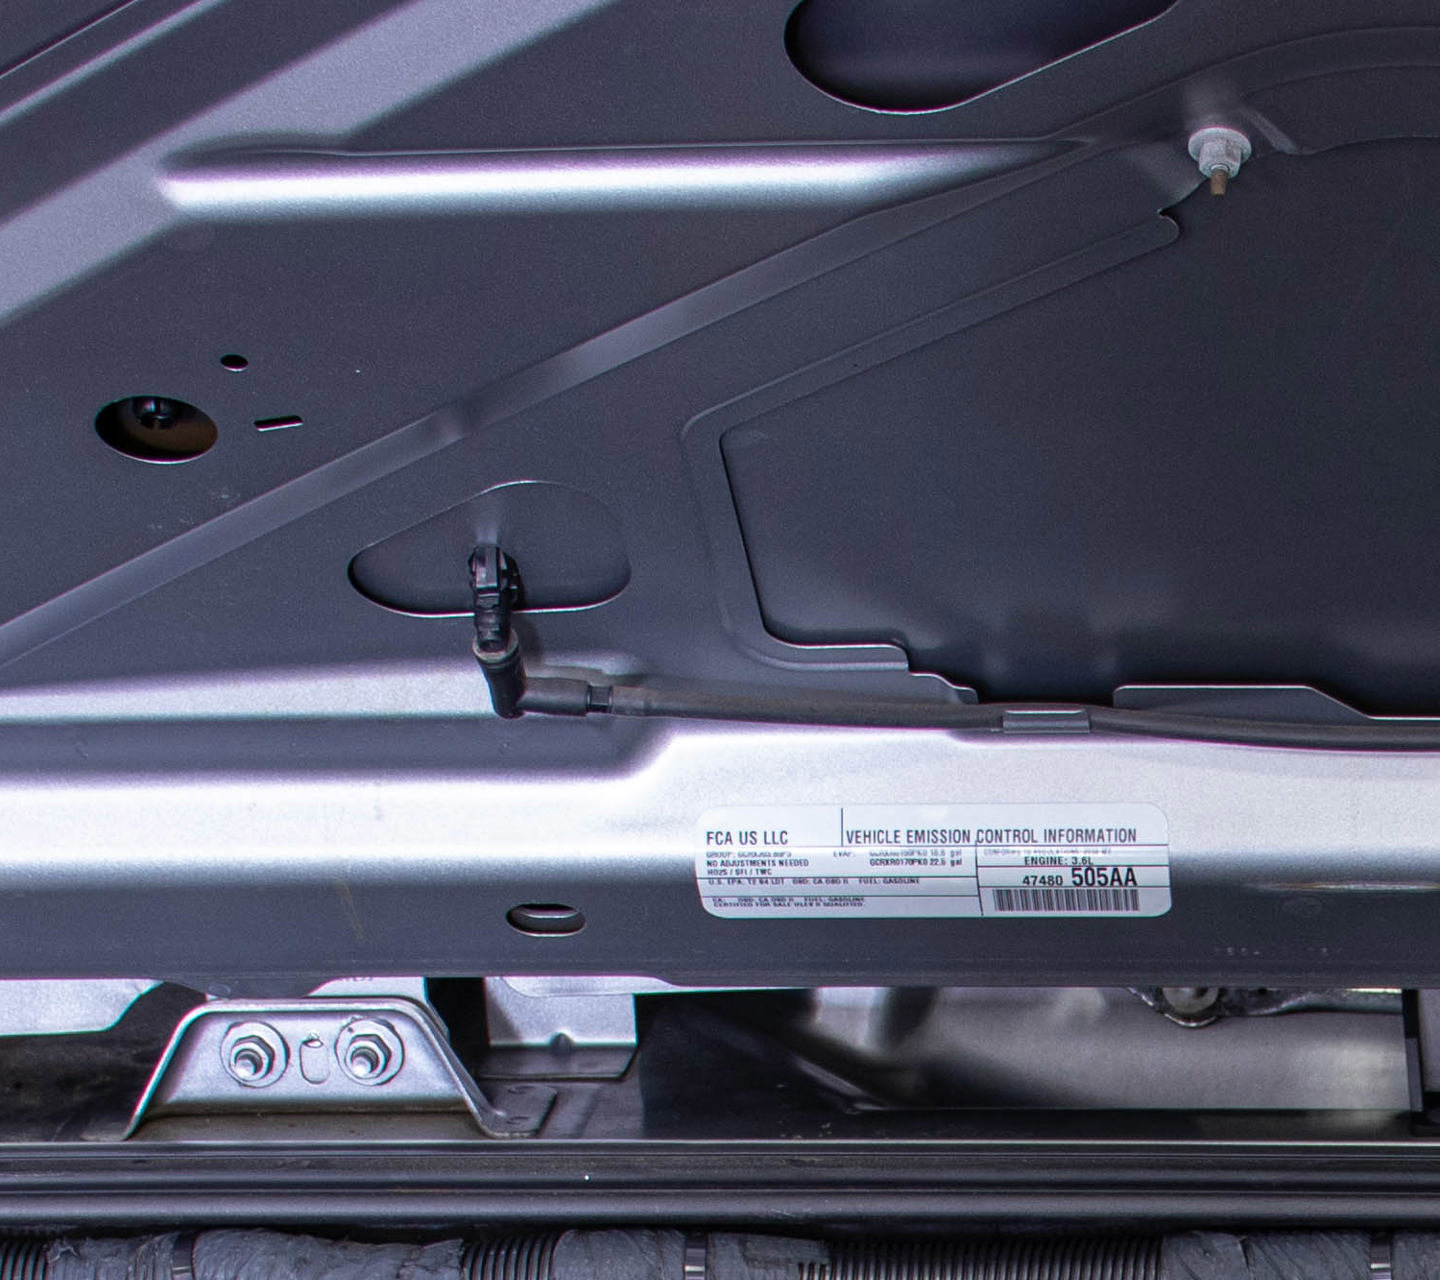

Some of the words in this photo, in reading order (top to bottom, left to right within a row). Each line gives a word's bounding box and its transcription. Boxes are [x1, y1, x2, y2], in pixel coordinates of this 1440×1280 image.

[706, 831, 733, 845] FCA
[739, 831, 757, 845] US
[763, 831, 788, 845] LLC
[846, 829, 902, 844] VEHICLE
[906, 829, 970, 844] EMISSION
[976, 829, 1038, 844] CONTROL
[1044, 828, 1137, 843] INFORMATION
[706, 859, 718, 867] NO
[720, 859, 777, 867] ADJUSTMENTS
[778, 859, 809, 867] NEEDED
[1024, 856, 1068, 866] ENGINE:
[1071, 857, 1094, 867] 3.6L
[1022, 875, 1064, 887] 47480
[1071, 867, 1138, 887] 505AA
